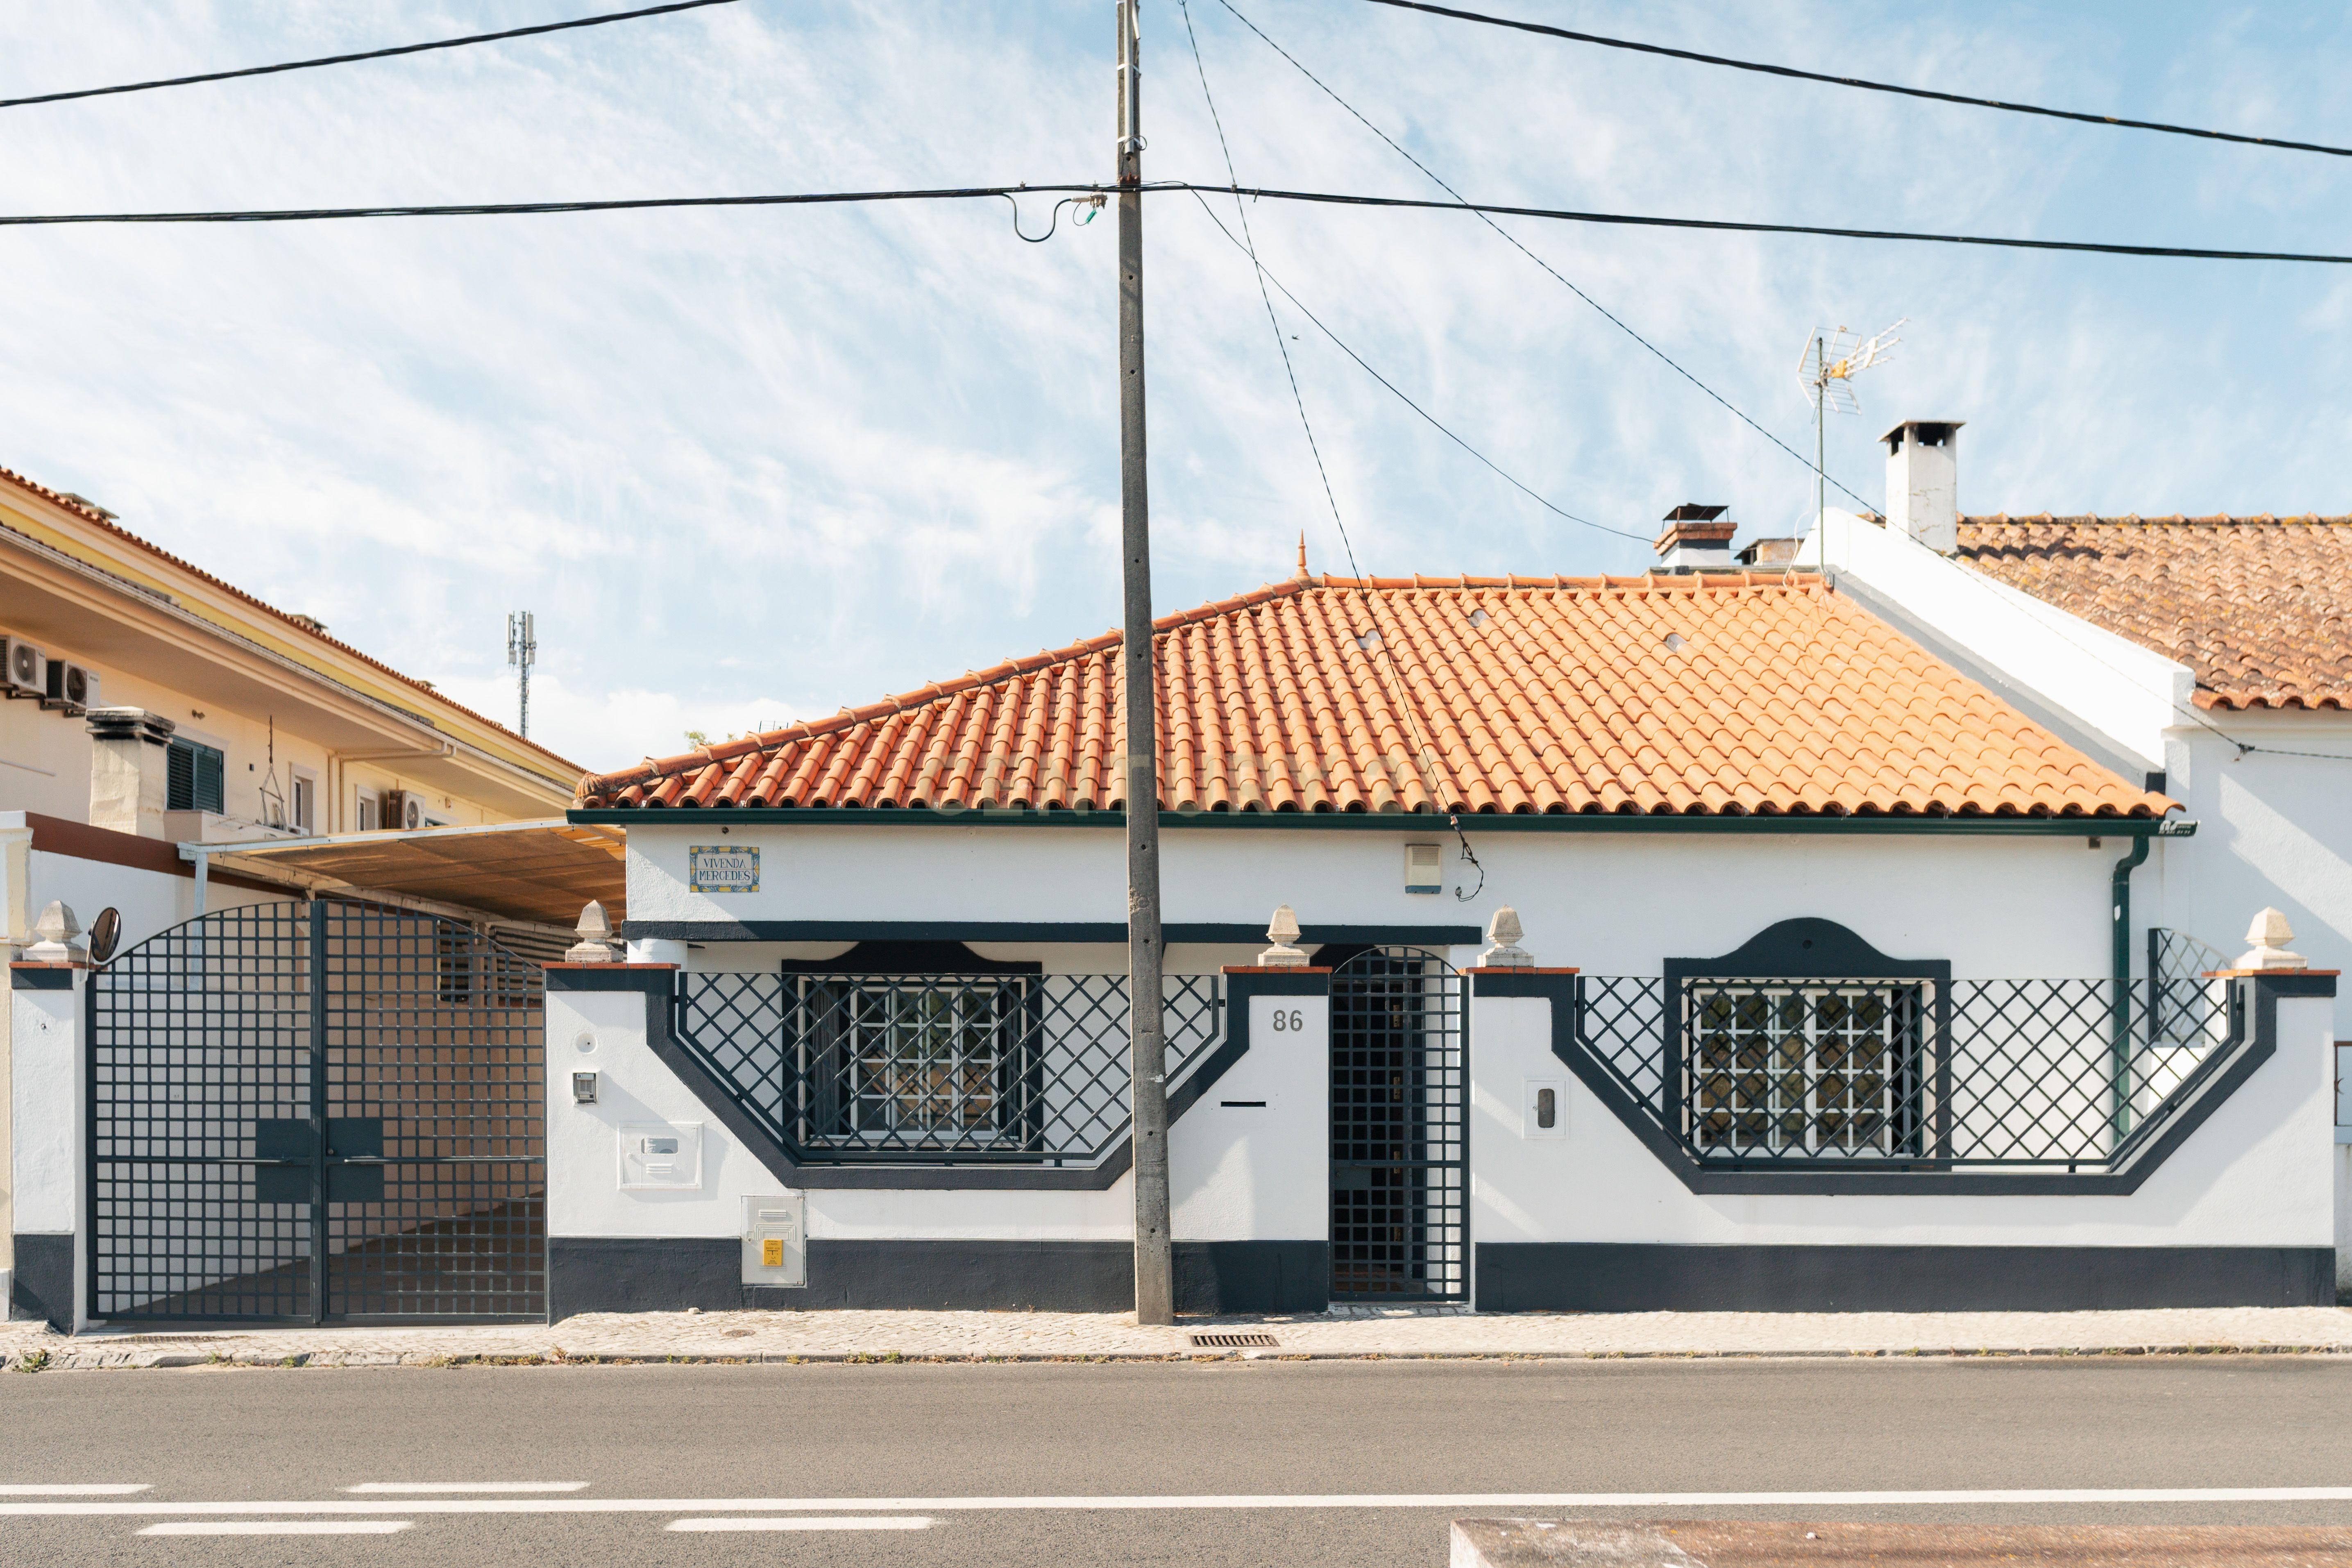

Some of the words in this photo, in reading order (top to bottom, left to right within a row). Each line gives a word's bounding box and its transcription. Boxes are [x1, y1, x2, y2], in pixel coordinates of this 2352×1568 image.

[704, 858, 746, 868] VIVENDA
[699, 871, 751, 880] MERCEDES
[1273, 1010, 1303, 1032] 86
